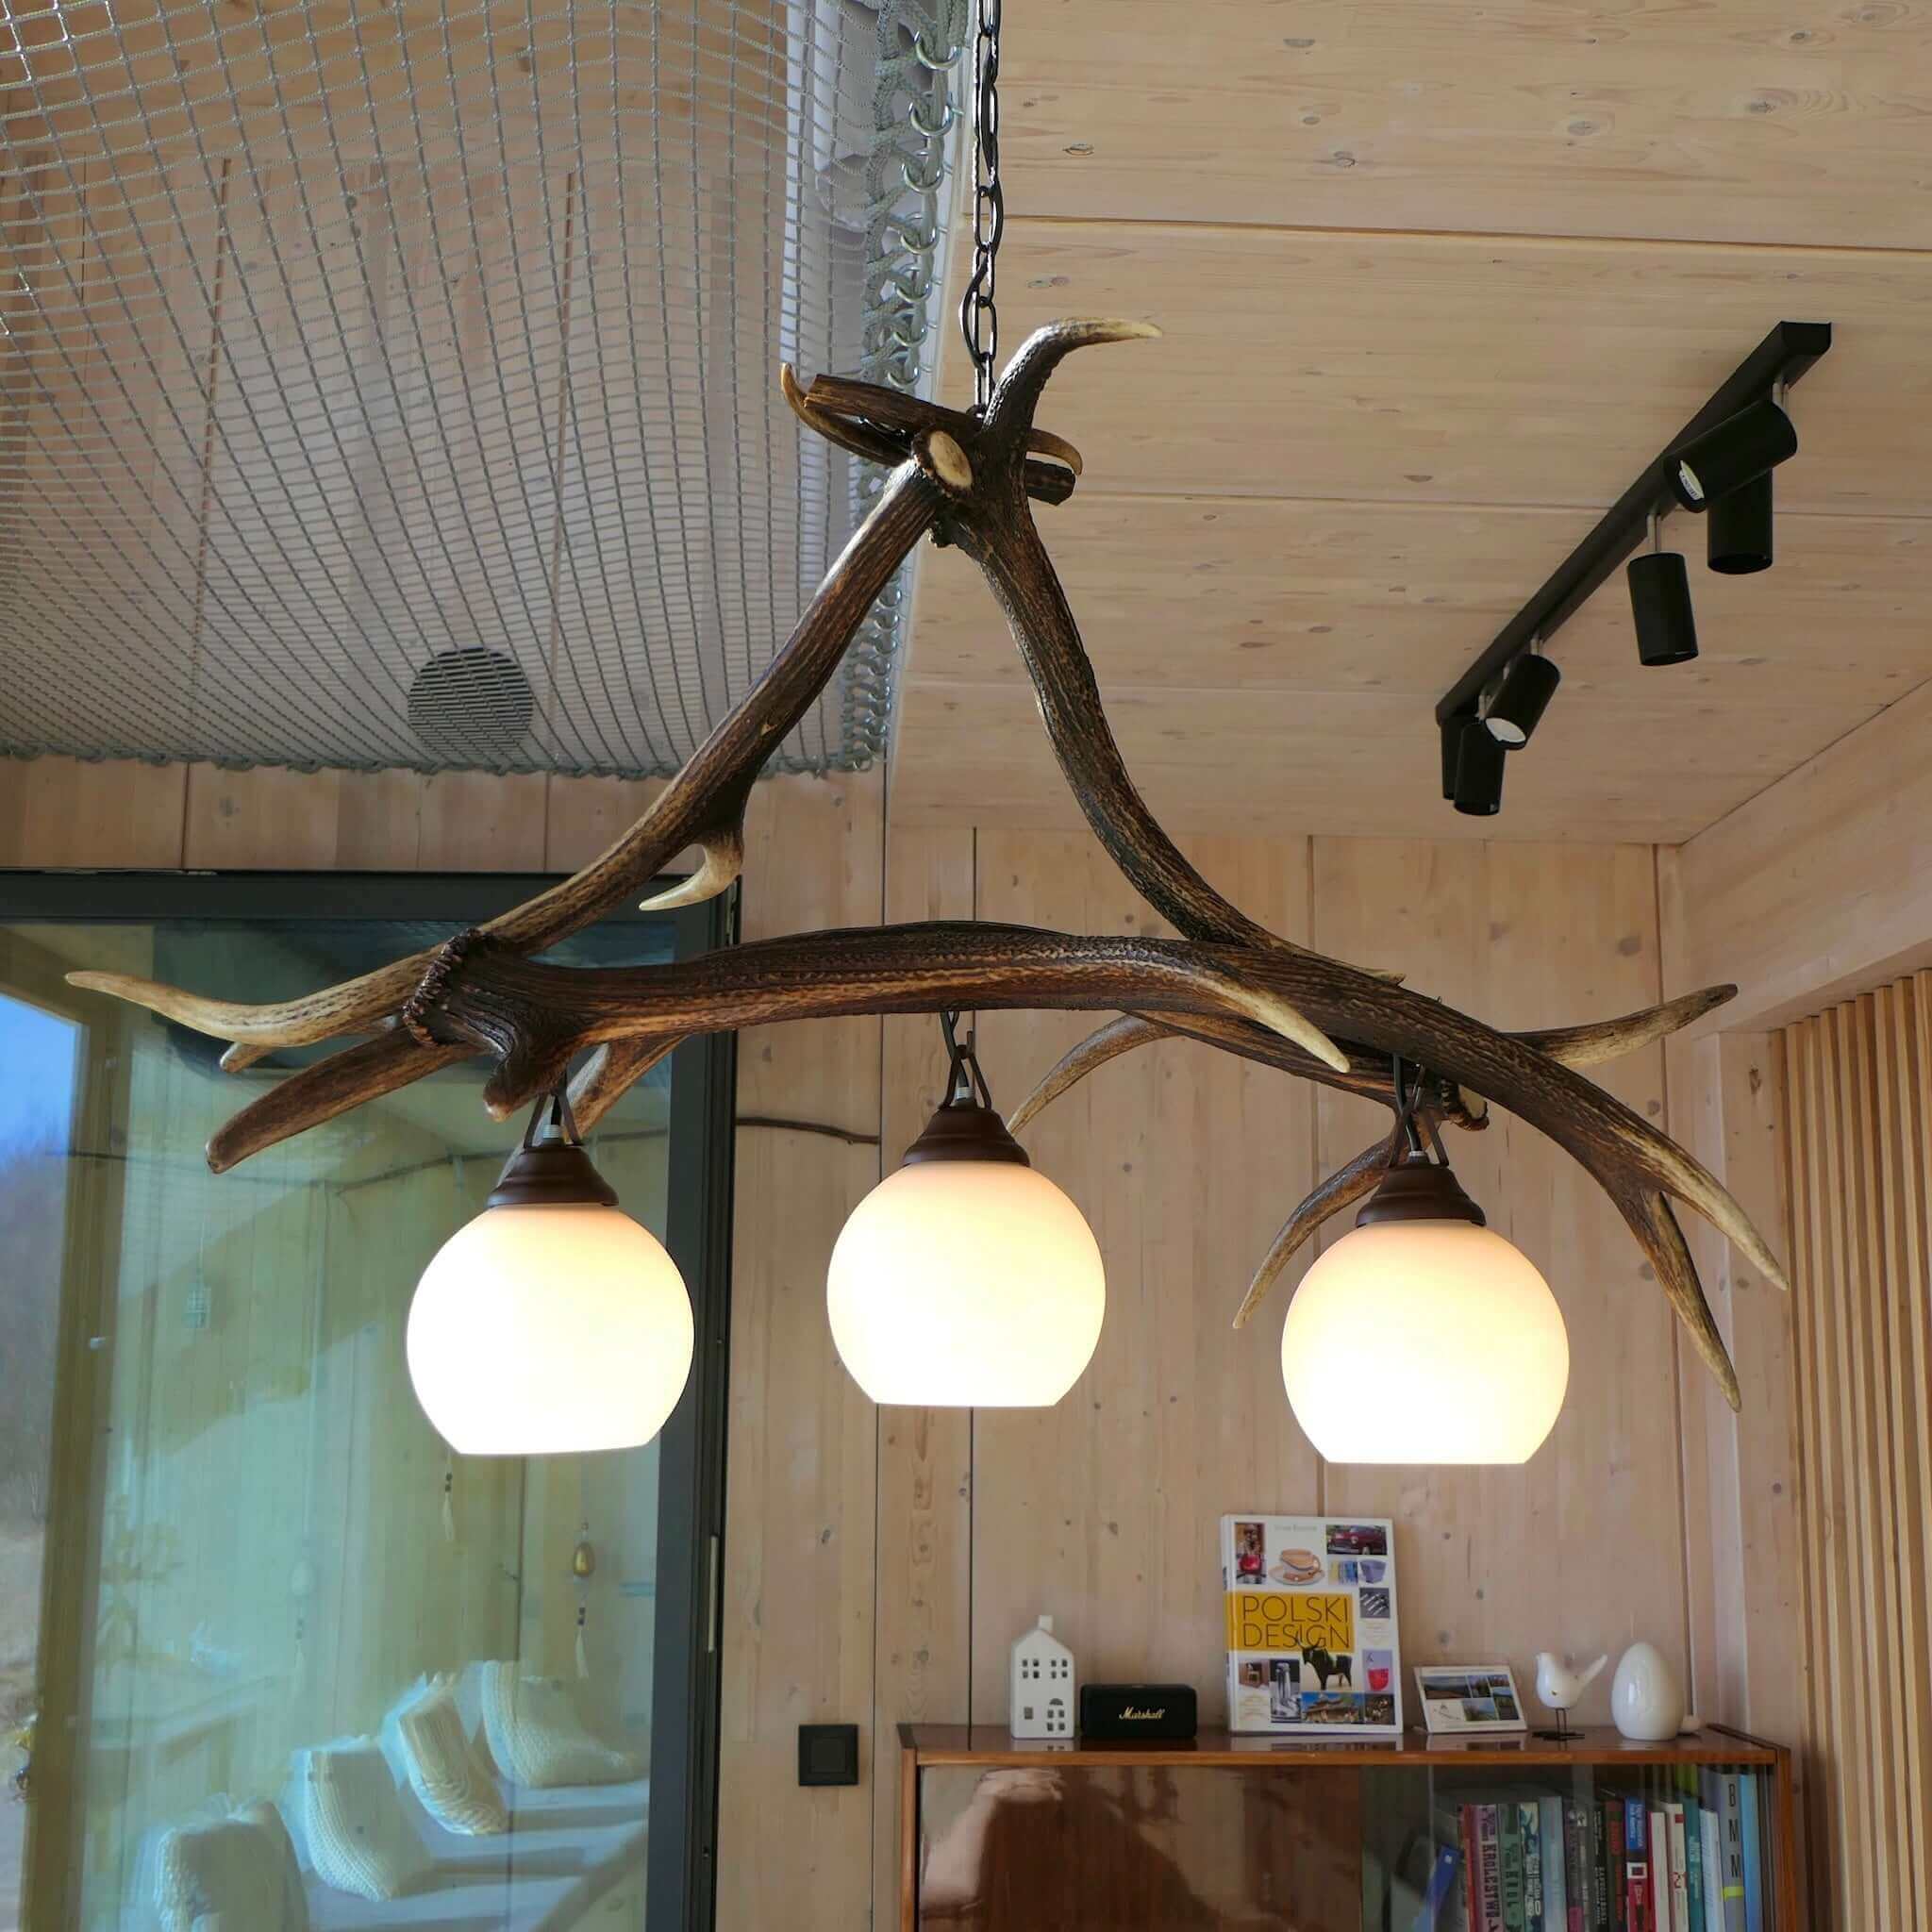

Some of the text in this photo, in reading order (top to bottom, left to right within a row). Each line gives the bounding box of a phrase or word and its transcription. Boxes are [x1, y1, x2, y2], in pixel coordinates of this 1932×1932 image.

[1242, 1595, 1348, 1623] POLSKI
[1242, 1623, 1350, 1649] DESIGN
[1119, 1707, 1165, 1720] Marshall
